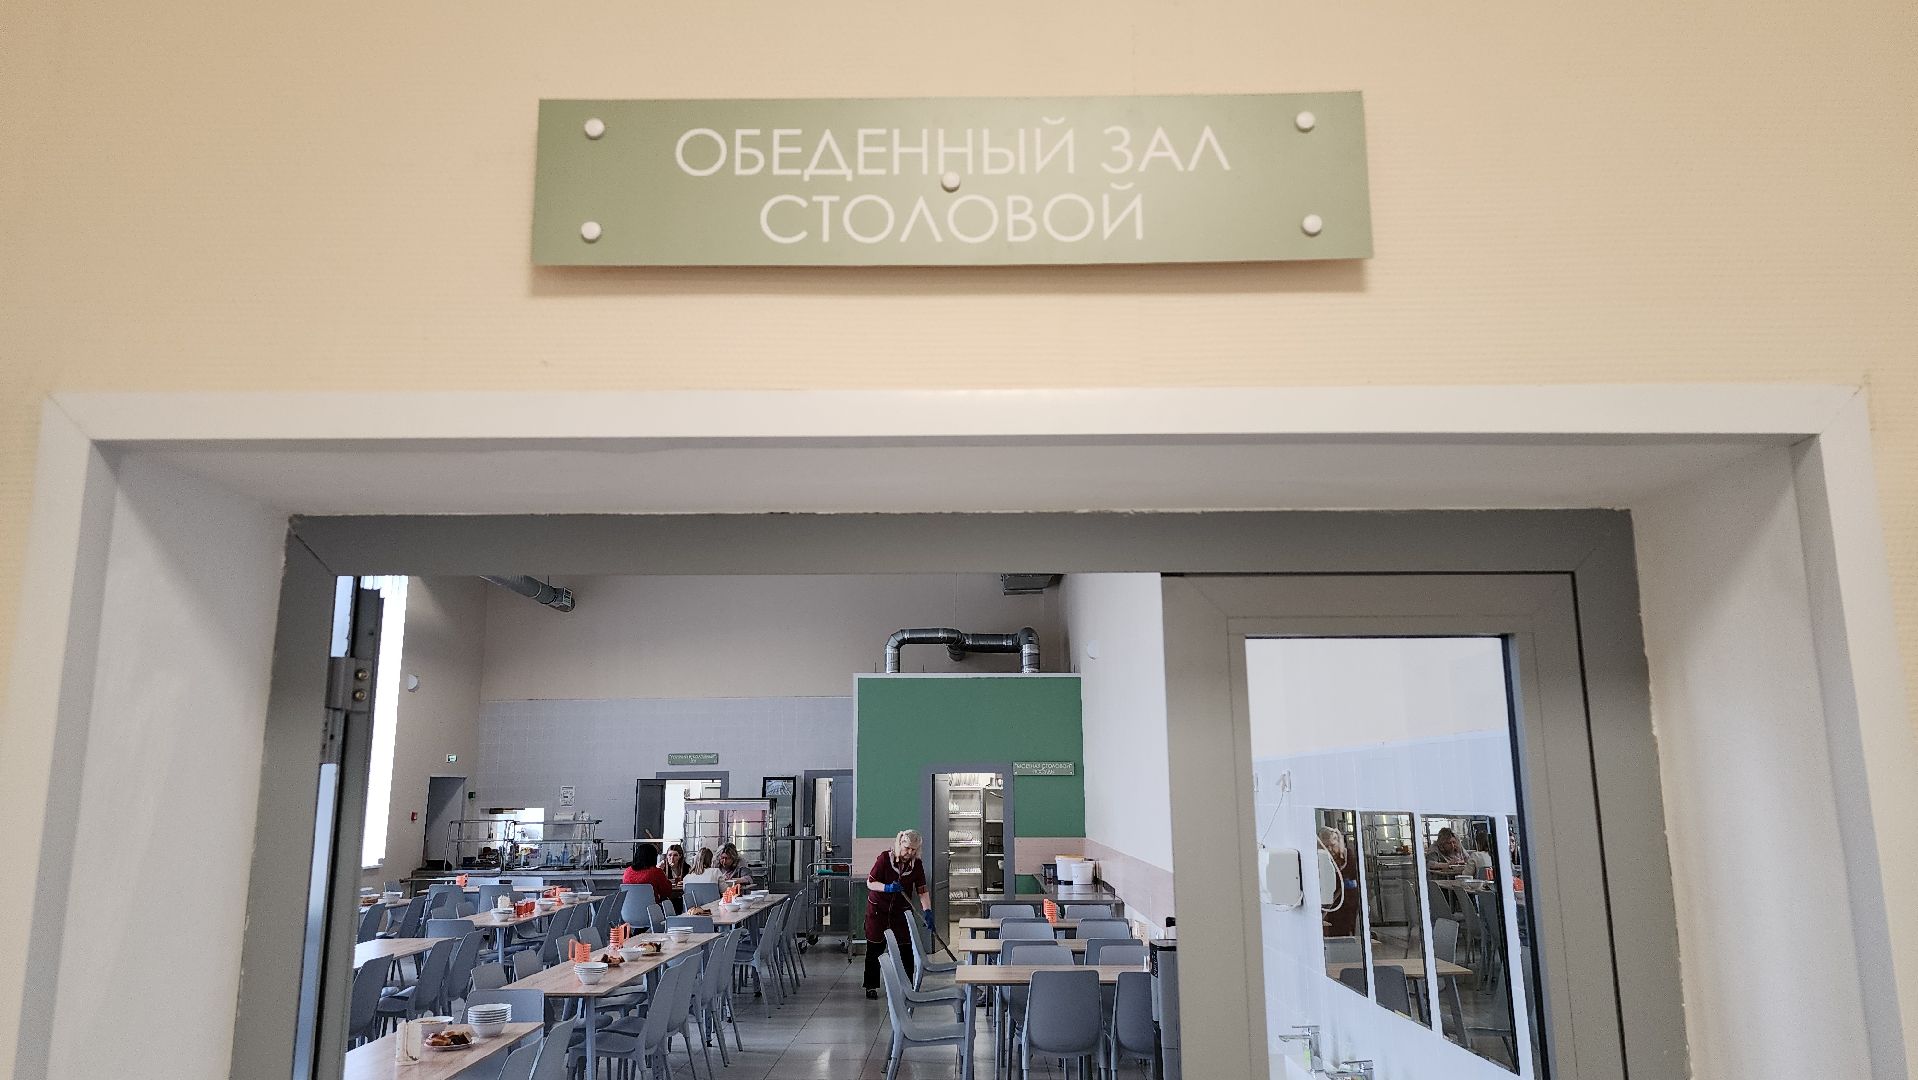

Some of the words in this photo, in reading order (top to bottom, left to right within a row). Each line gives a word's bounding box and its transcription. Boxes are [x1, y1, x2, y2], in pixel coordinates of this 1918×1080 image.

[675, 117, 1077, 182] ОБЕДЕННЫЙ
[1102, 126, 1231, 173] ЗАЛ
[759, 184, 1144, 245] СТОЛОВОЙ
